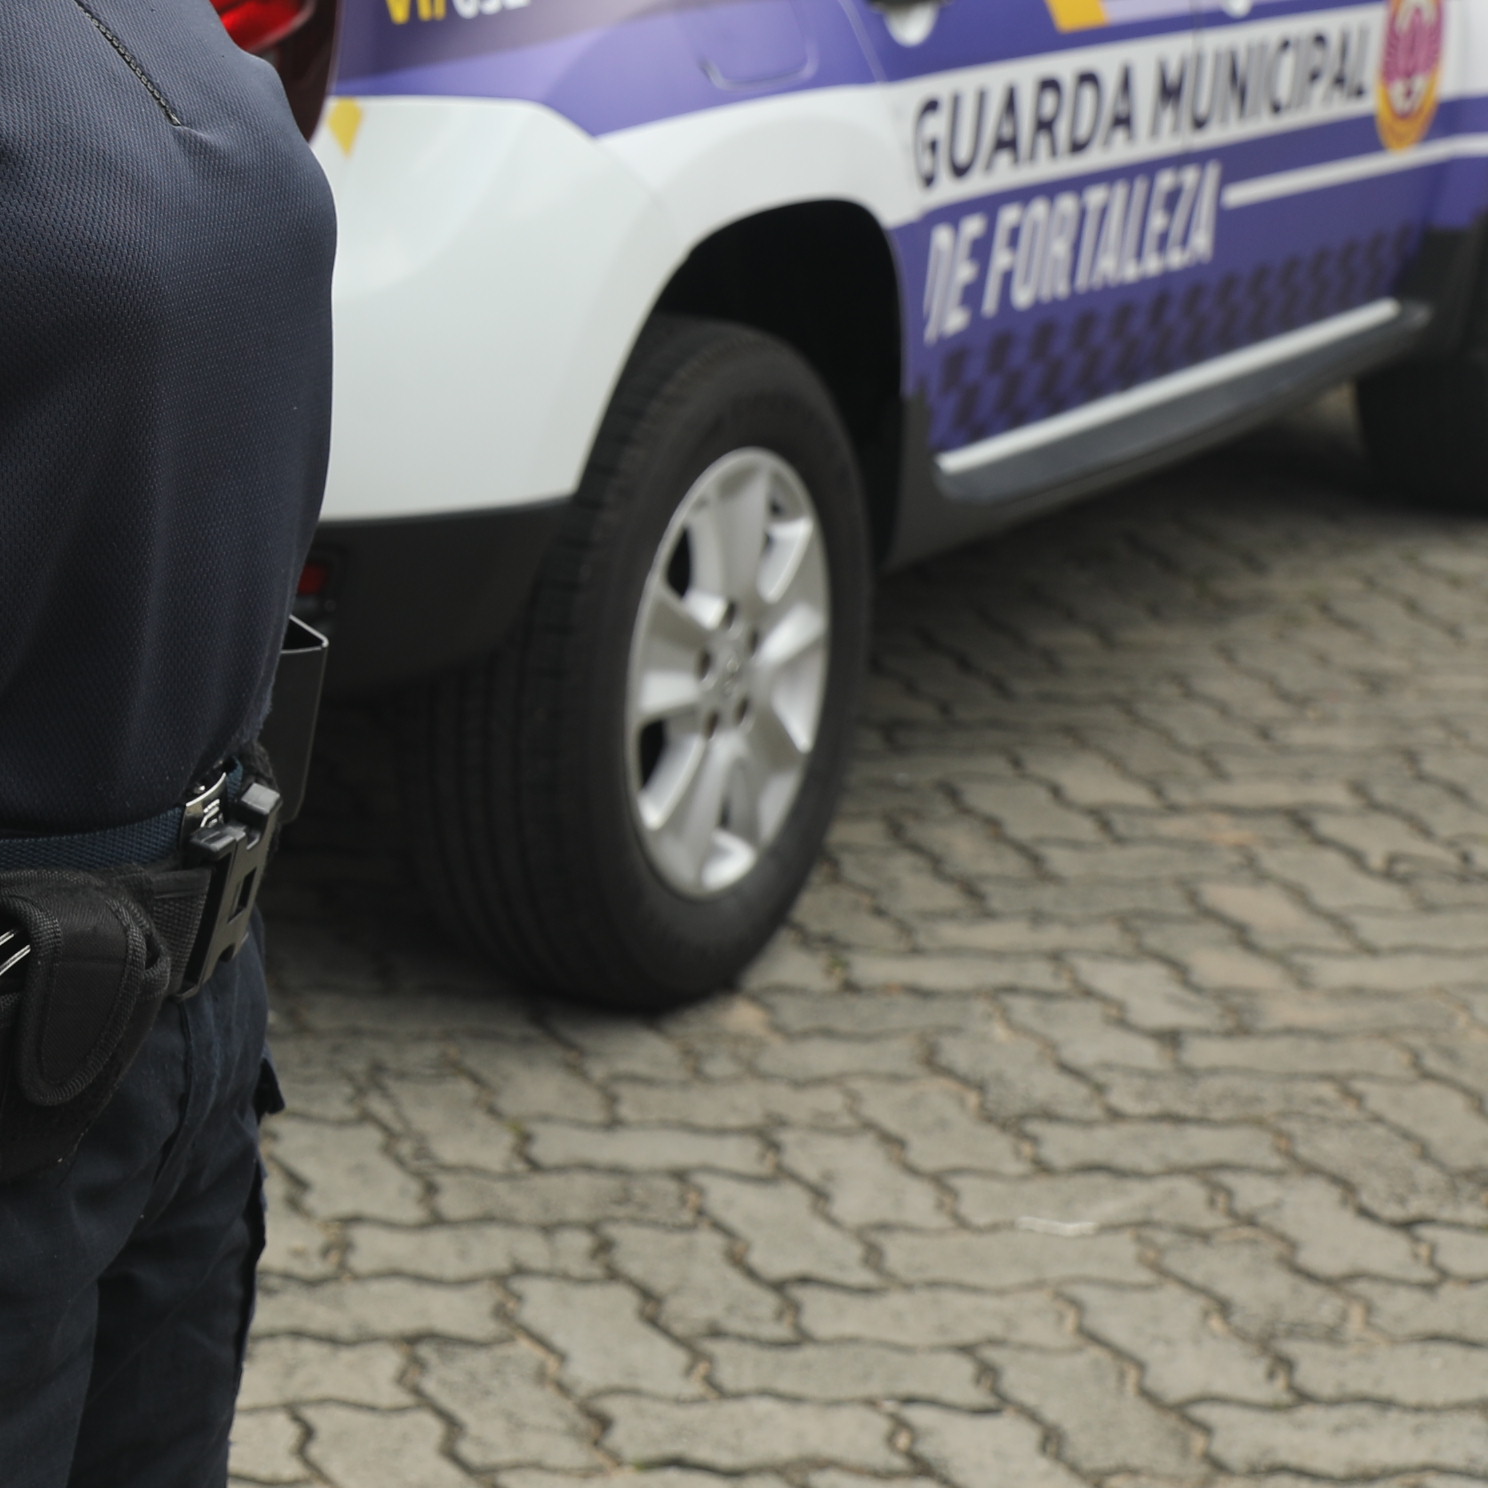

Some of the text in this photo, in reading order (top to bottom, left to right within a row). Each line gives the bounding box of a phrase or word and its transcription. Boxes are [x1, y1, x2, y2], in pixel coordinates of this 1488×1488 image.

[913, 25, 1371, 190] GUARDA MUNICIPAL
[924, 159, 1221, 346] DE FORTALEZA
